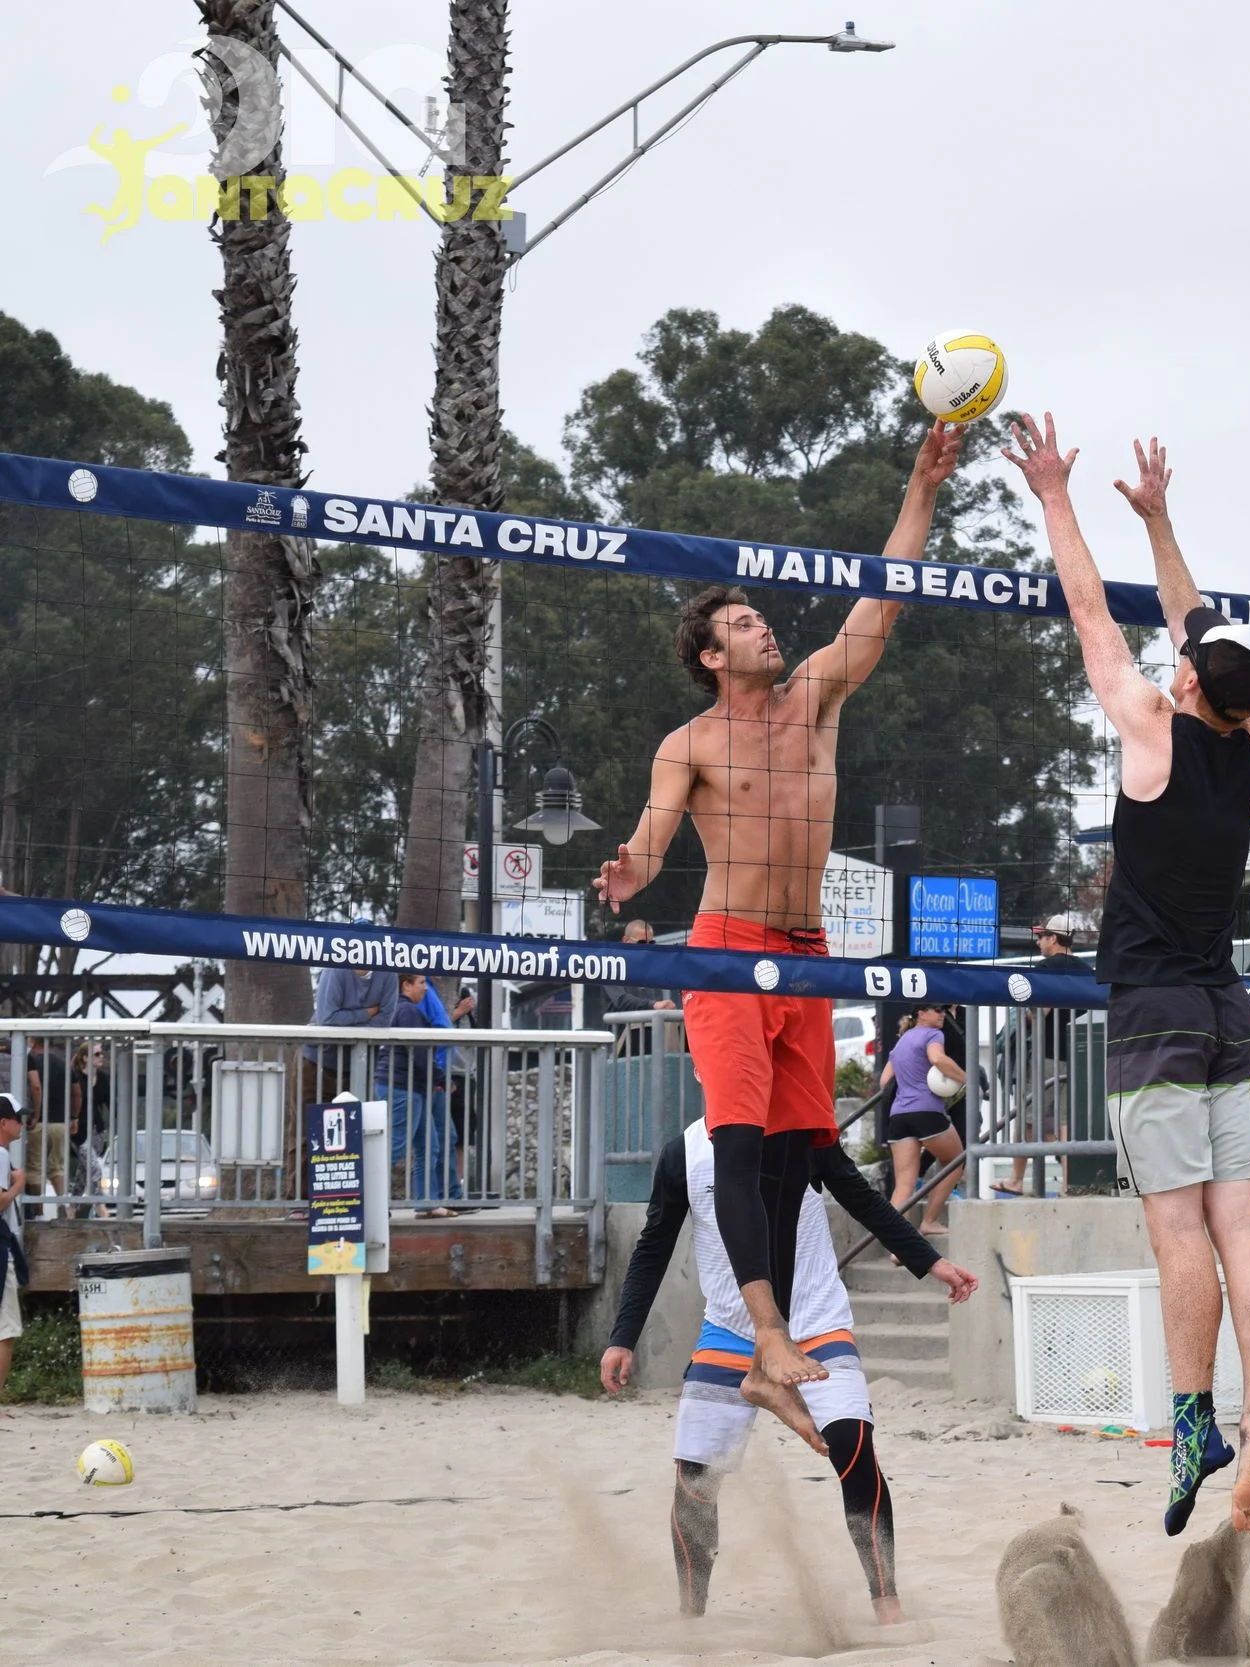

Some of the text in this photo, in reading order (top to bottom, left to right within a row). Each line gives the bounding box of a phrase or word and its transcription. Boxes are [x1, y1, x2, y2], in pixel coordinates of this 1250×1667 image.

[926, 340, 946, 375] Wilson
[949, 382, 981, 408] Wilson
[322, 499, 484, 548] SANTA
[497, 519, 628, 564] CRUZ
[736, 546, 1048, 608] MAIN BEACH
[825, 868, 876, 884] EACH
[822, 886, 876, 902] TREET
[912, 880, 996, 913] Ocean View
[822, 904, 847, 917] NN
[825, 919, 877, 935] UITES
[912, 917, 996, 934] ROOMS & SUITES
[242, 930, 628, 981] www.santacruzwharf.com
[914, 937, 993, 954] POOL & FIRE PIT
